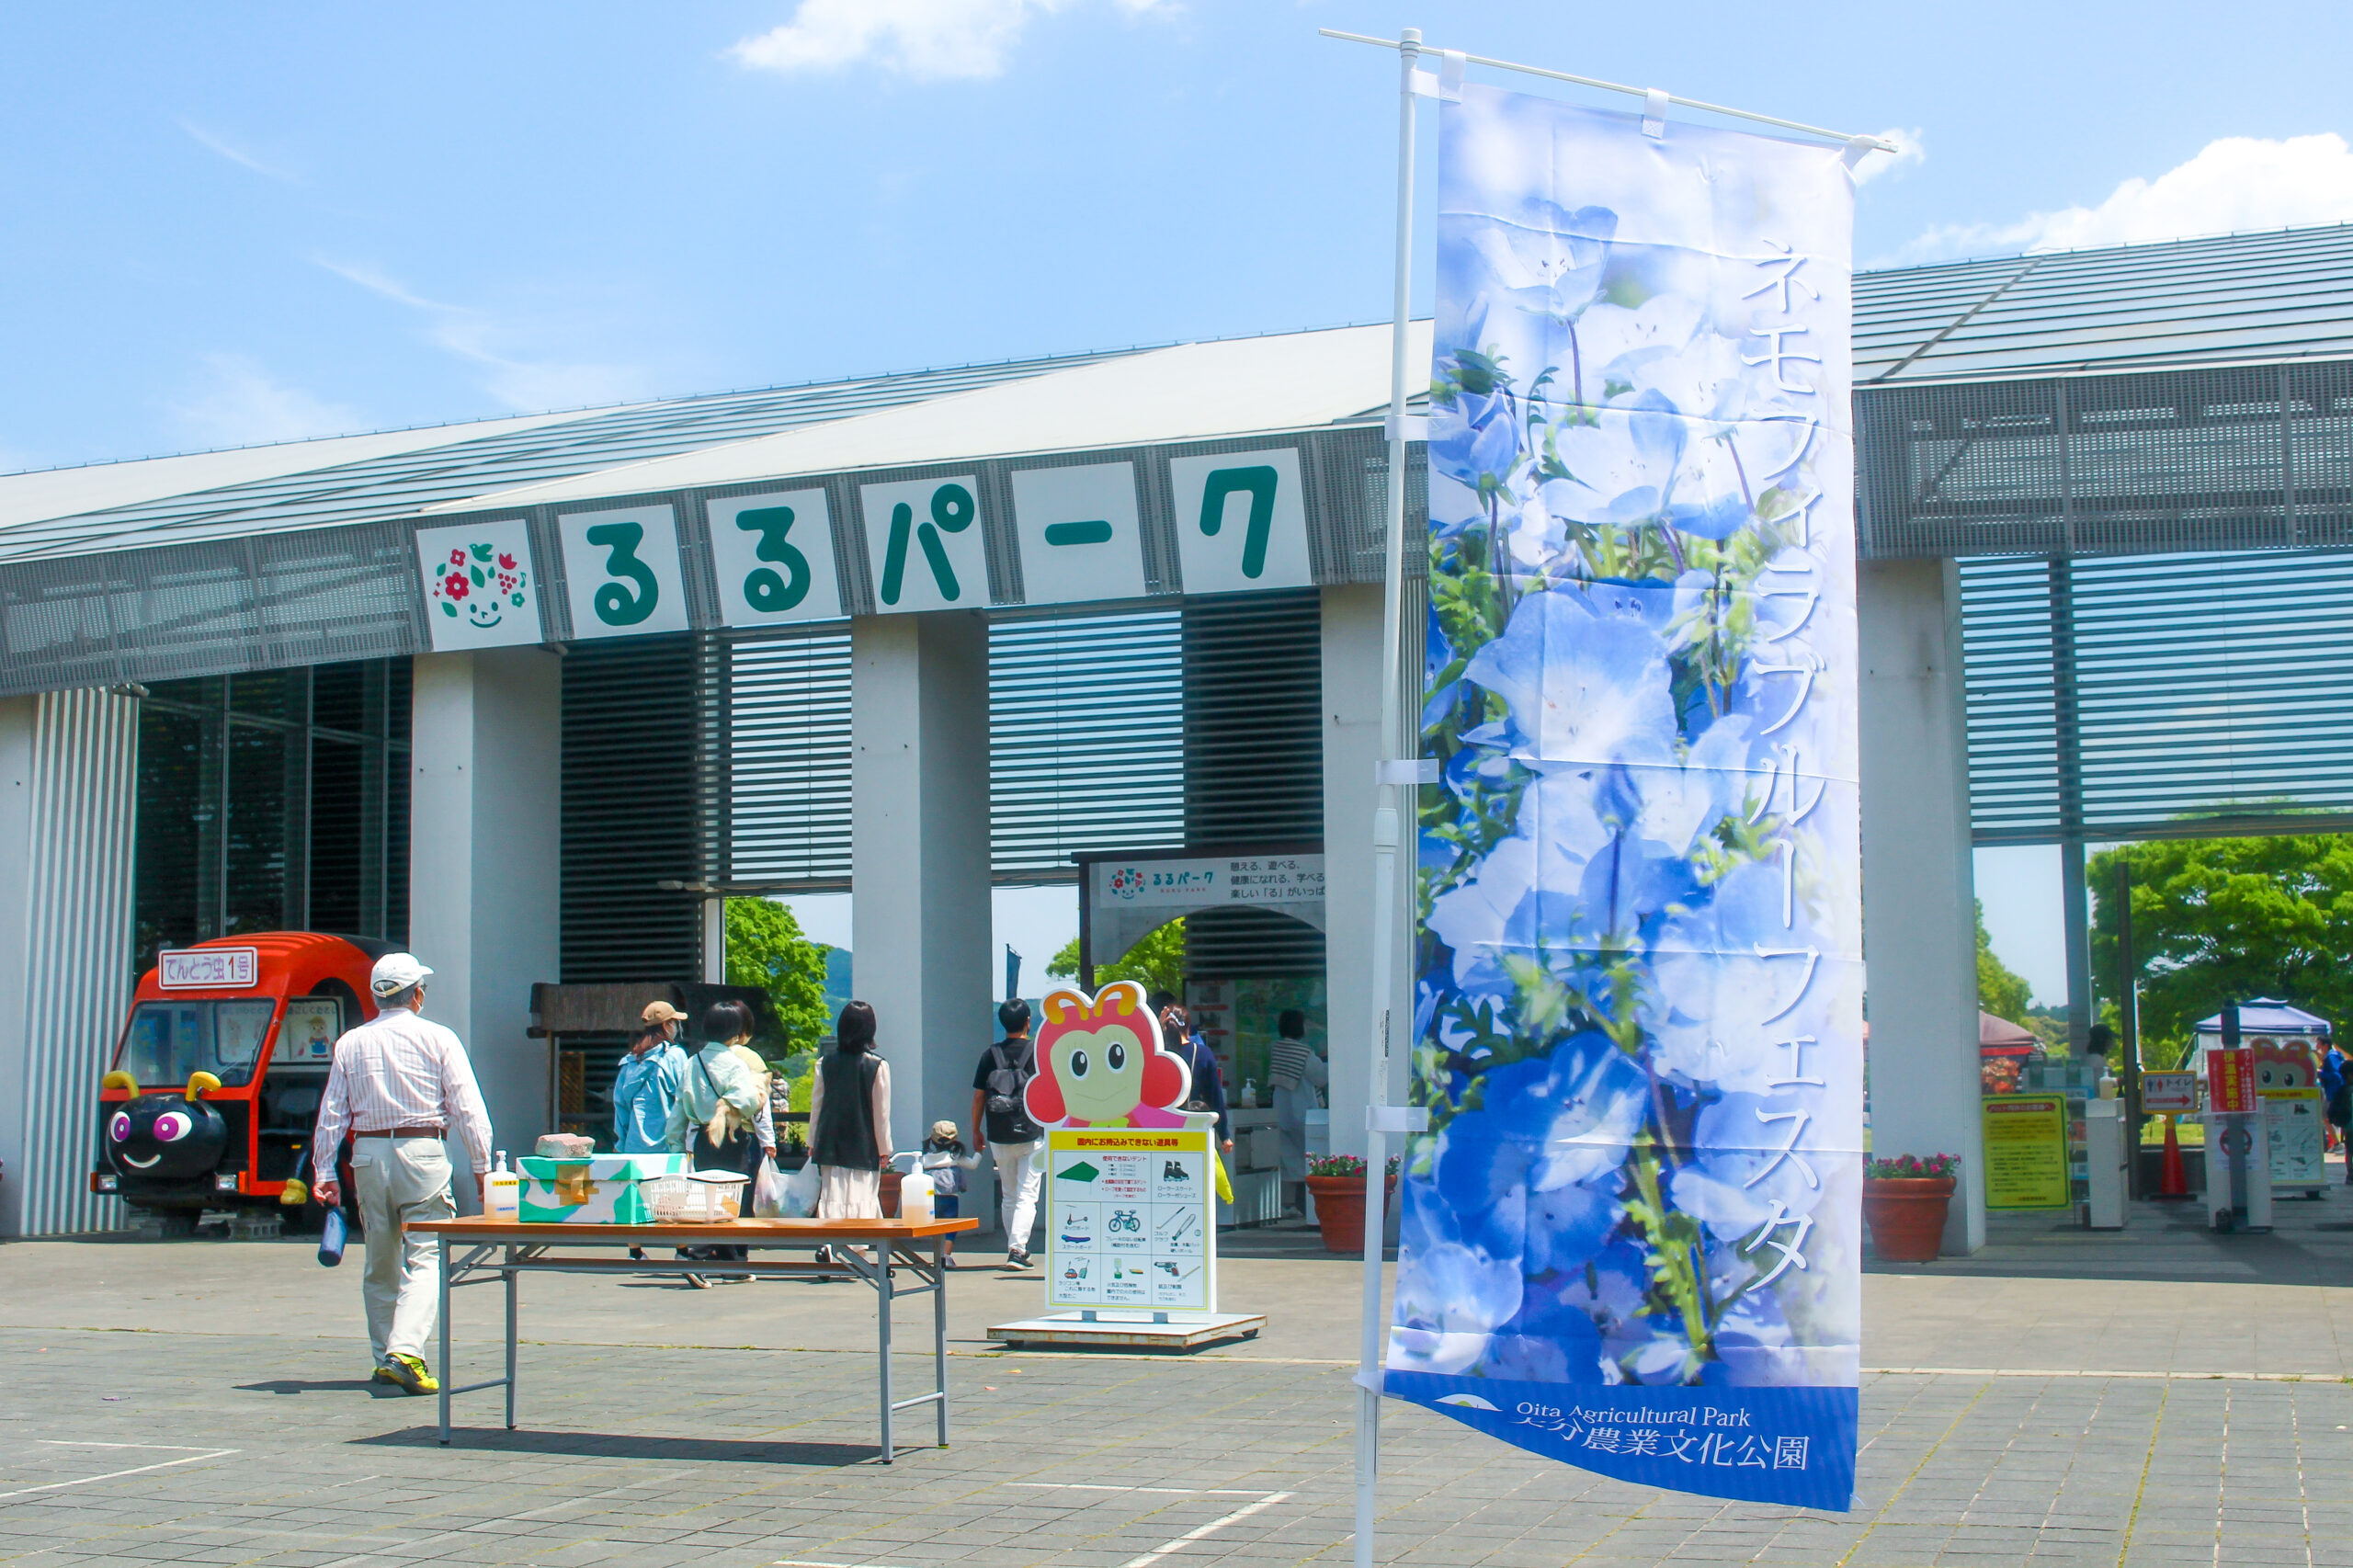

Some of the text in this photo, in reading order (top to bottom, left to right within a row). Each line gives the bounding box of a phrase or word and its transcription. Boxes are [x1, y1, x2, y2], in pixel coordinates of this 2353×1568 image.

[585, 464, 1279, 627] るるパーク
[1741, 236, 1826, 1293] ネモフィラブルーフェスタ
[1154, 872, 1212, 885] るるパーク
[166, 956, 249, 981] てんとう虫1号
[2165, 1078, 2192, 1088] トイレ
[1516, 1402, 1750, 1426] Oita Agricultural Park
[1507, 1416, 1810, 1471] 大分農業文化公園
